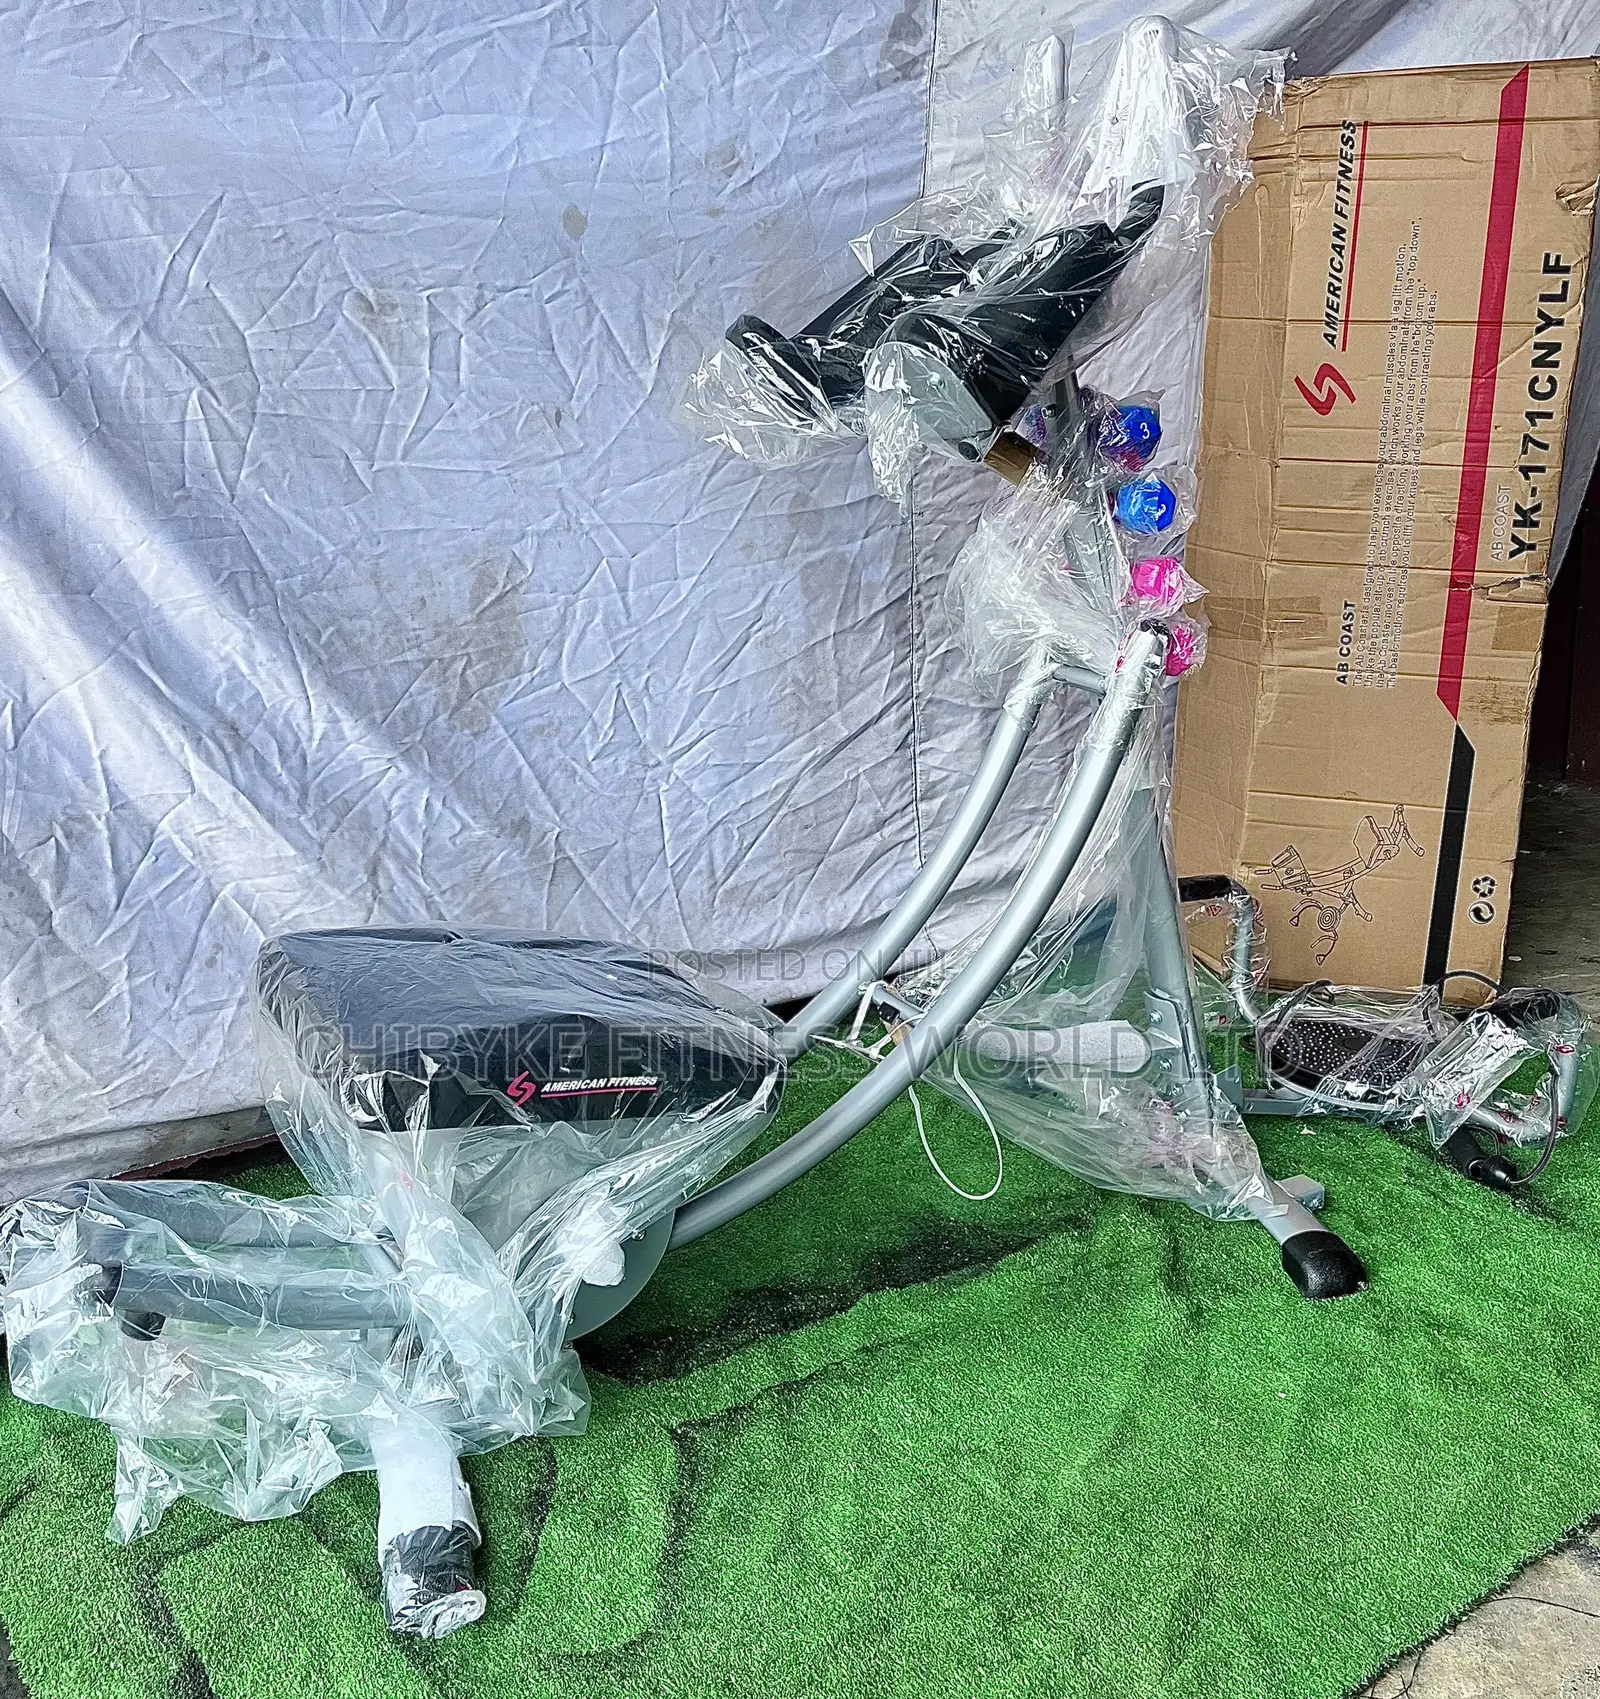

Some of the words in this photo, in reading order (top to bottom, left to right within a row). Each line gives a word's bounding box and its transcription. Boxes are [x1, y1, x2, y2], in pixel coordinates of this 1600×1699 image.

[1332, 118, 1357, 220] FITNESS
[1393, 242, 1407, 282] motion.
[1321, 221, 1348, 349] AMERICAN
[1392, 283, 1402, 297] lift
[1404, 277, 1415, 294] the
[1390, 298, 1403, 315] leg
[1401, 295, 1413, 320] from
[1425, 289, 1437, 312] abs.
[1425, 313, 1436, 335] your
[1395, 320, 1410, 379] abdominals
[1409, 338, 1420, 356] the
[1383, 341, 1396, 383] muscles
[1407, 357, 1418, 381] from
[1416, 338, 1433, 396] contracting
[1394, 380, 1406, 403] your
[1404, 382, 1415, 401] abs
[1377, 385, 1392, 438] abdominal
[1404, 402, 1415, 426] your
[1414, 397, 1425, 424] while
[1508, 250, 1572, 563] YK-171CNYLF
[1139, 422, 1151, 440] 3
[1389, 405, 1401, 436] works
[1398, 427, 1413, 466] working
[1411, 425, 1424, 447] legs
[1377, 439, 1388, 463] your
[1386, 436, 1398, 465] which
[1409, 448, 1420, 467] and
[1371, 462, 1384, 505] exercise
[1381, 467, 1396, 512] exercise,
[1393, 467, 1408, 514] direction,
[1406, 468, 1418, 499] knees
[1370, 506, 1381, 524] you
[1405, 499, 1416, 522] your
[1492, 483, 1511, 537] COAST
[1366, 525, 1379, 547] help
[1378, 513, 1390, 547] crunch
[1388, 515, 1403, 557] opposite
[1402, 523, 1412, 536] lift
[1365, 548, 1375, 558] to
[1376, 548, 1386, 561] ab
[1400, 537, 1410, 548] to
[1489, 538, 1503, 561] AB
[1386, 559, 1397, 574] the
[1400, 549, 1411, 567] you
[1360, 559, 1376, 604] designed
[1372, 573, 1386, 602] sit-up
[1385, 575, 1395, 585] in
[1394, 568, 1409, 608] requires
[1360, 604, 1369, 613] is
[1383, 586, 1394, 618] moves
[1337, 599, 1356, 658] COAST
[1368, 602, 1383, 639] popular
[1391, 609, 1403, 642] motion
[1355, 614, 1368, 652] Coaster
[1378, 618, 1391, 657] Coaster
[1366, 639, 1377, 656] the
[1388, 642, 1399, 669] basic
[1354, 653, 1364, 667] Ab
[1363, 657, 1375, 687] Unlike
[1376, 658, 1387, 671] Ab
[1335, 661, 1349, 685] AB
[1352, 667, 1363, 687] The
[1374, 671, 1385, 688] the
[1386, 670, 1396, 689] The
[541, 1078, 606, 1093] AMERICAN
[608, 1076, 658, 1087] FITNESS
